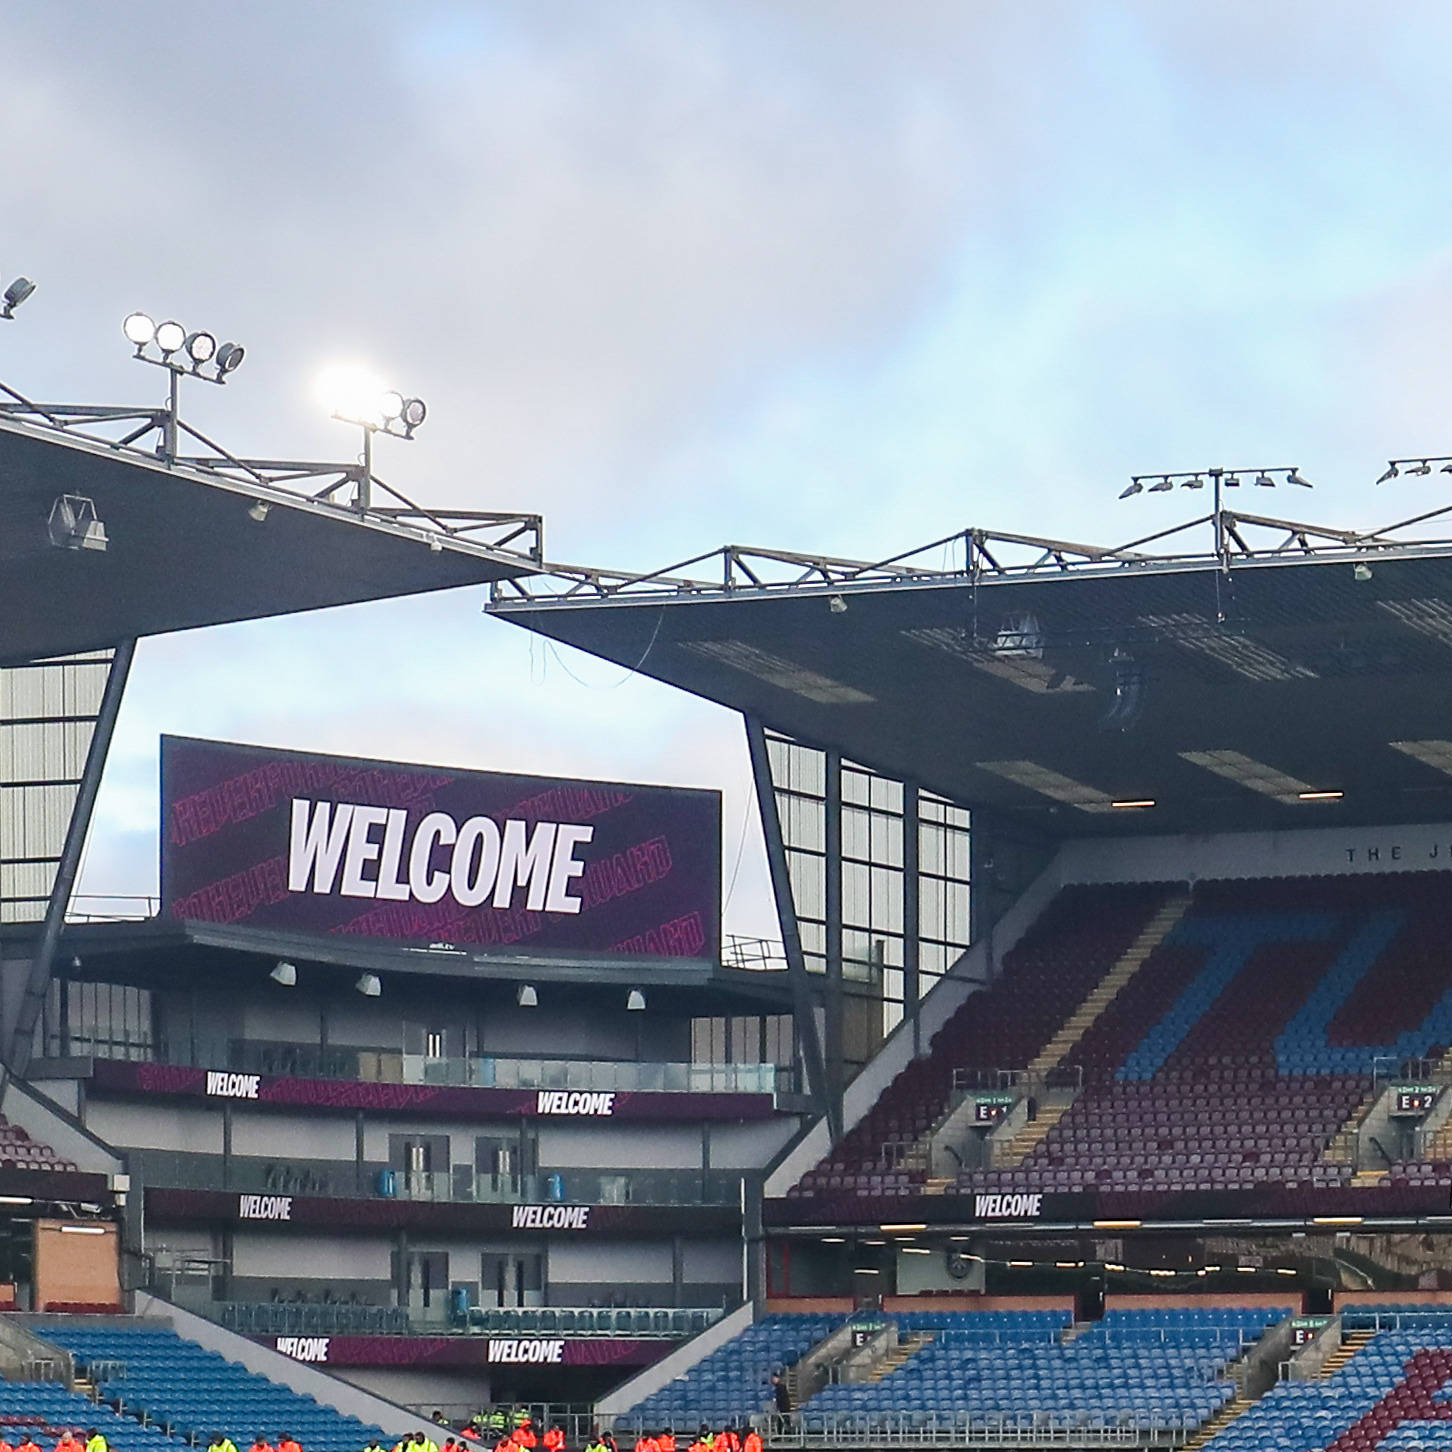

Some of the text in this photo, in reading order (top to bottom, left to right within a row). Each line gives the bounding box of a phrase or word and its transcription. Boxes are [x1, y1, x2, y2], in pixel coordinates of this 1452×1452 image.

[287, 798, 594, 914] WELCOME
[1346, 847, 1401, 862] THE
[206, 1071, 260, 1098] WELCOME
[537, 1091, 616, 1115] WELCOME
[980, 1105, 988, 1119] E
[1402, 1095, 1433, 1108] E 2
[240, 1195, 292, 1220] WELCOME
[512, 1205, 590, 1229] WELCOME
[975, 1193, 1042, 1218] WELCOME
[276, 1337, 330, 1361] WELCOME
[855, 1333, 864, 1346] E
[1295, 1330, 1304, 1344] E
[487, 1340, 566, 1363] WELCOME
